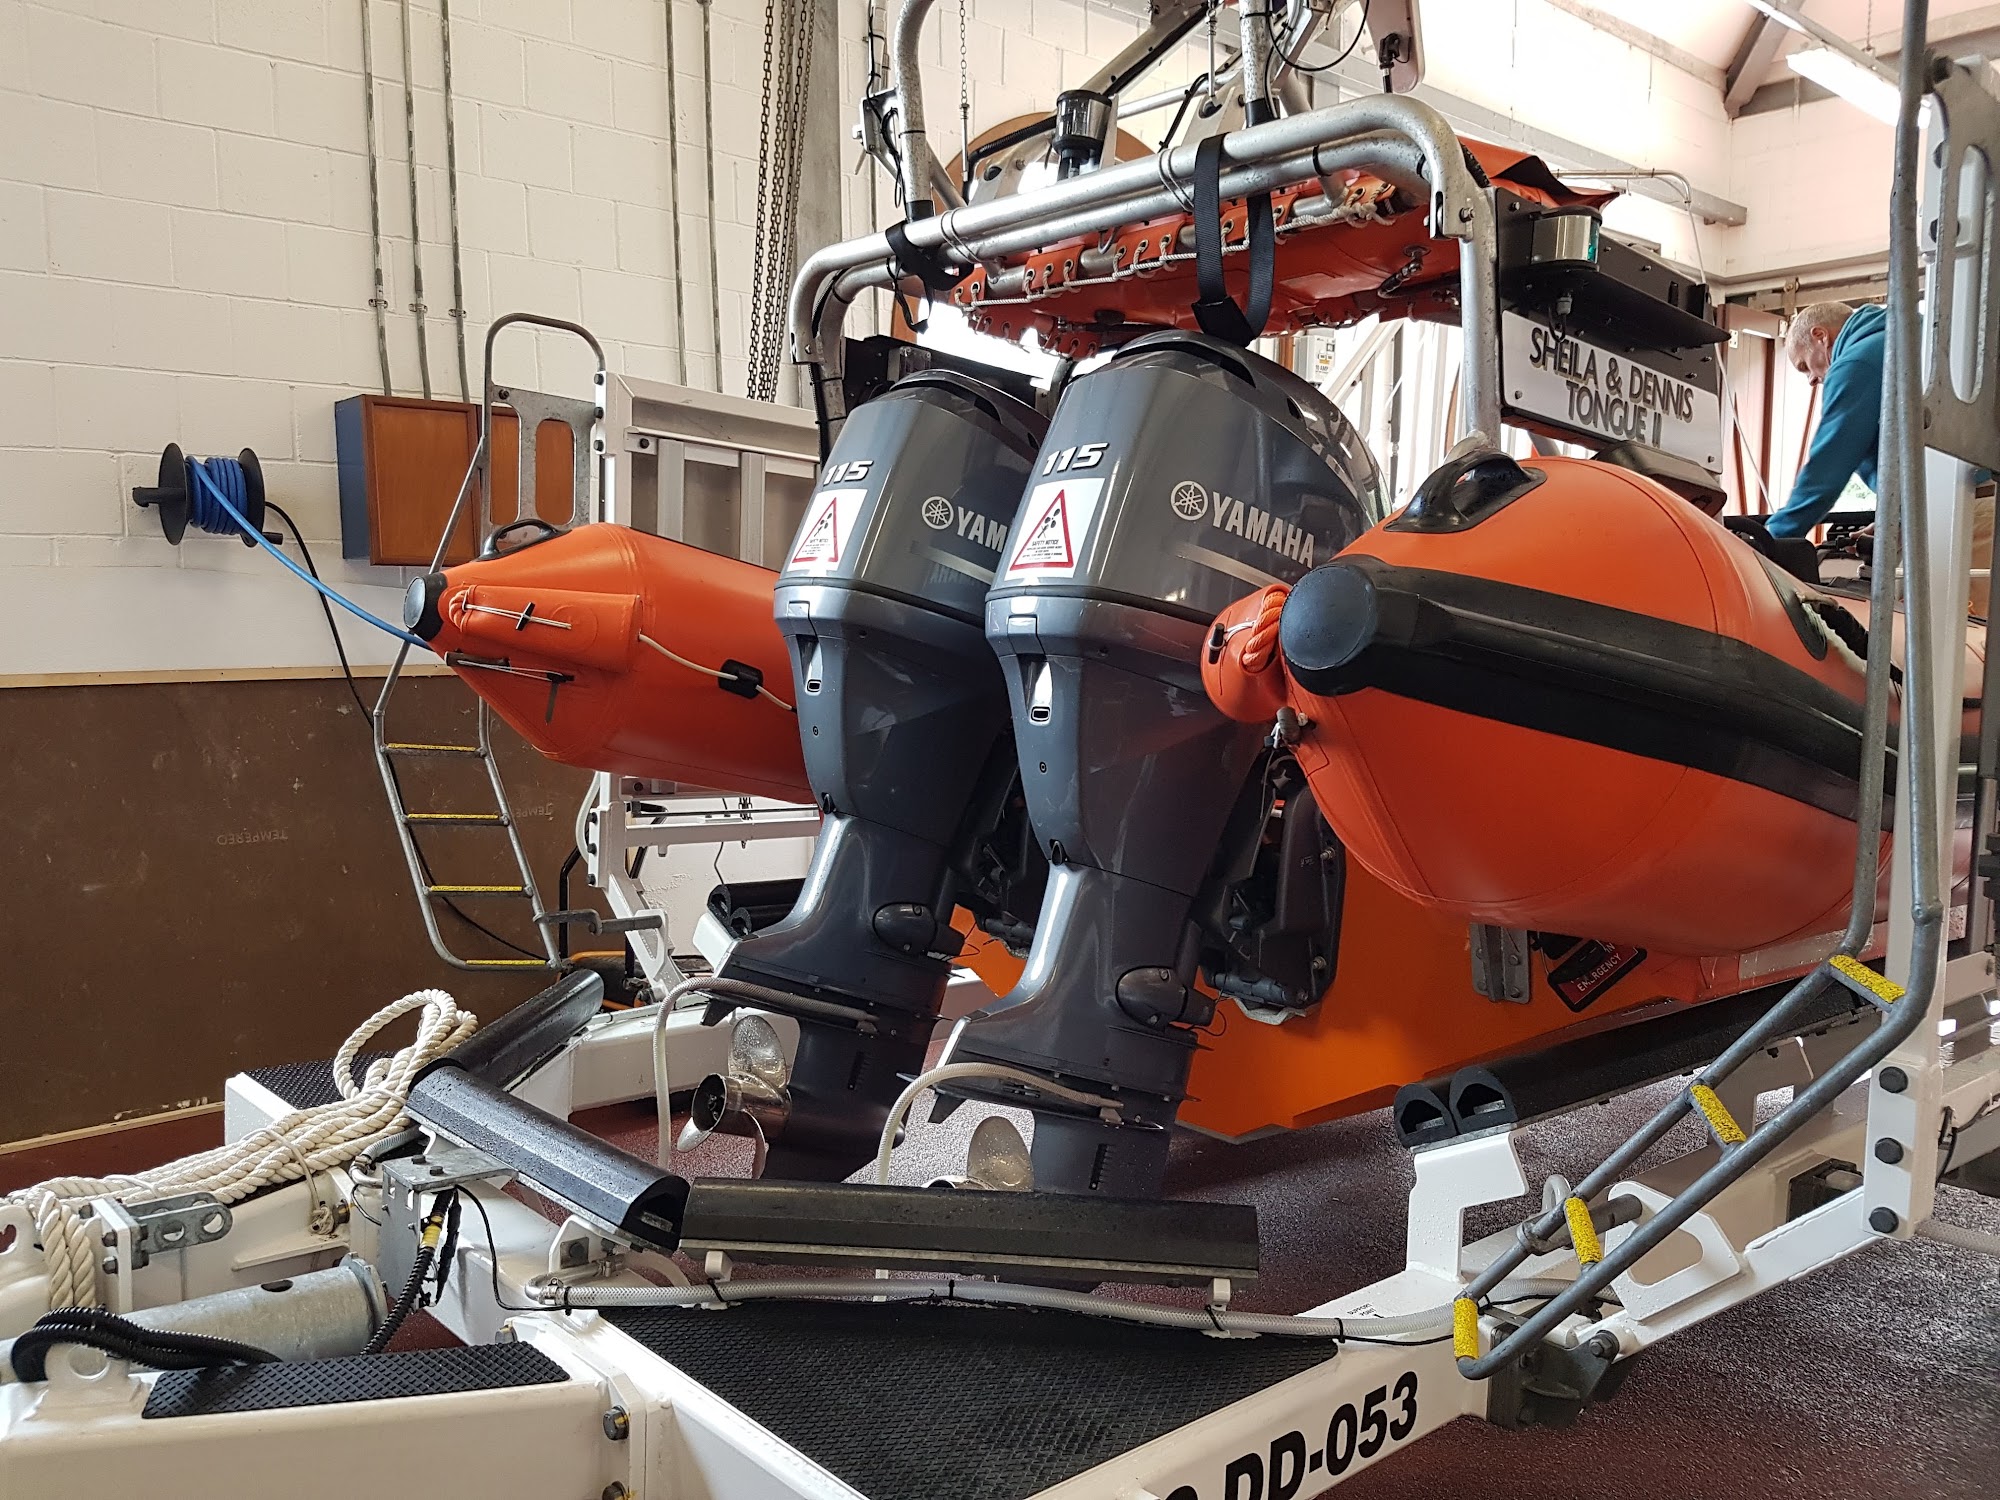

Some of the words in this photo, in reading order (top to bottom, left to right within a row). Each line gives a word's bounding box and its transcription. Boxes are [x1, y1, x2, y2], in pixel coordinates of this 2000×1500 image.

[1530, 327, 1598, 387] SHEILA
[1605, 357, 1622, 397] &
[1629, 365, 1694, 423] DENNIS
[1566, 380, 1646, 440] TONGUE
[822, 460, 874, 487] 115
[1042, 442, 1109, 476] 115
[957, 506, 1009, 553] YAM
[1212, 491, 1316, 568] YAMAHA
[1224, 1371, 1418, 1500] DD-053
